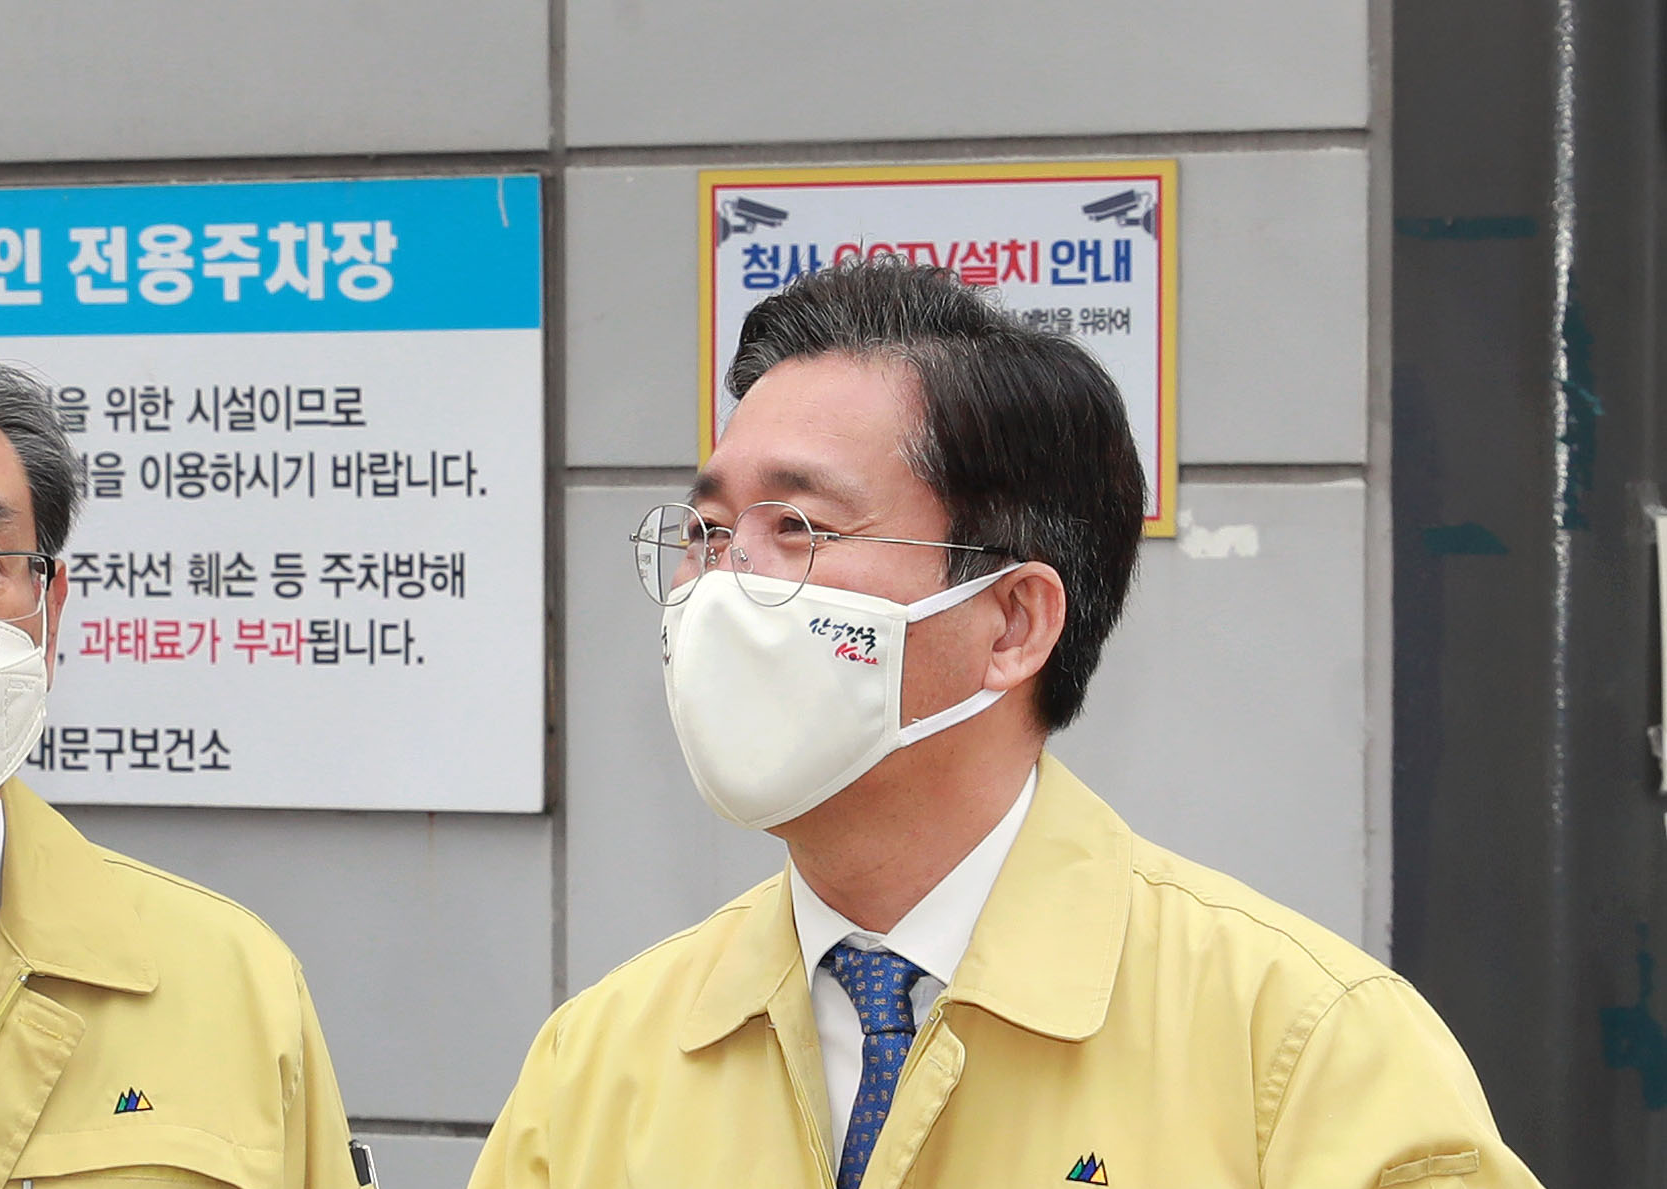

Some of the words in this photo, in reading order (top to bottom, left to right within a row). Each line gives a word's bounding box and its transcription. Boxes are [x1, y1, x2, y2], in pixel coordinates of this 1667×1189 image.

[66, 220, 398, 306] 전용주차장
[742, 242, 822, 290] 청사
[1049, 238, 1133, 286] 안내
[1078, 306, 1131, 336] 위하여
[102, 384, 175, 434] 위한
[186, 384, 368, 434] 시설이므로
[139, 450, 317, 499] 이용하시기
[331, 450, 489, 499] 바랍니다.
[67, 551, 175, 599] 주차선
[186, 551, 259, 599] 훼손
[269, 551, 308, 599] 등
[318, 550, 468, 599] 주차방해
[78, 617, 222, 665] 과태료가
[232, 617, 426, 666] 부과됩니다.
